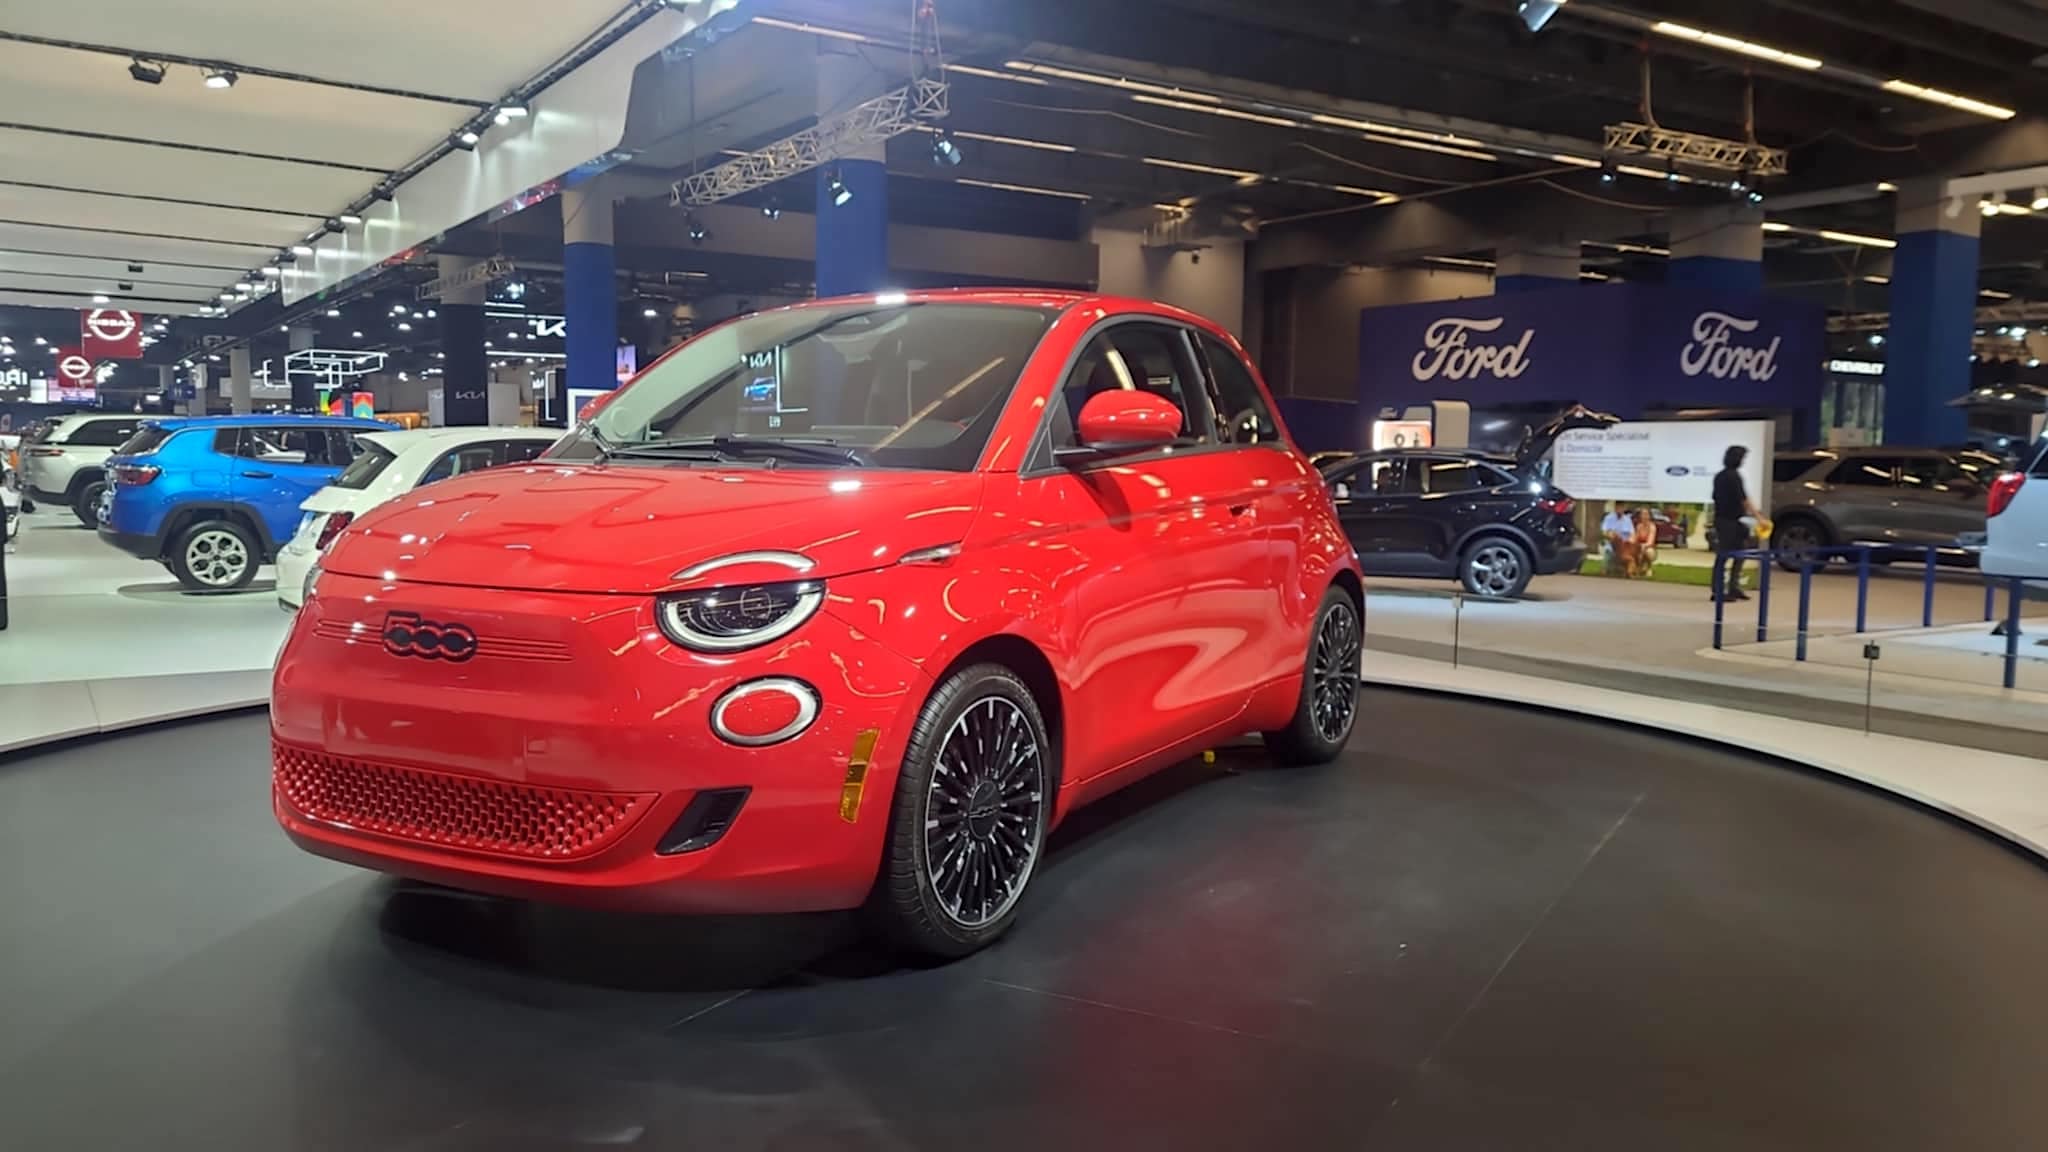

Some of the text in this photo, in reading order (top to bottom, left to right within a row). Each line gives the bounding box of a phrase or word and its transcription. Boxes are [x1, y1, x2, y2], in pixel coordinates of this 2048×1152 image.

[1412, 317, 1535, 381] Ford
[1681, 311, 1782, 382] Ford
[383, 610, 479, 663] 500
